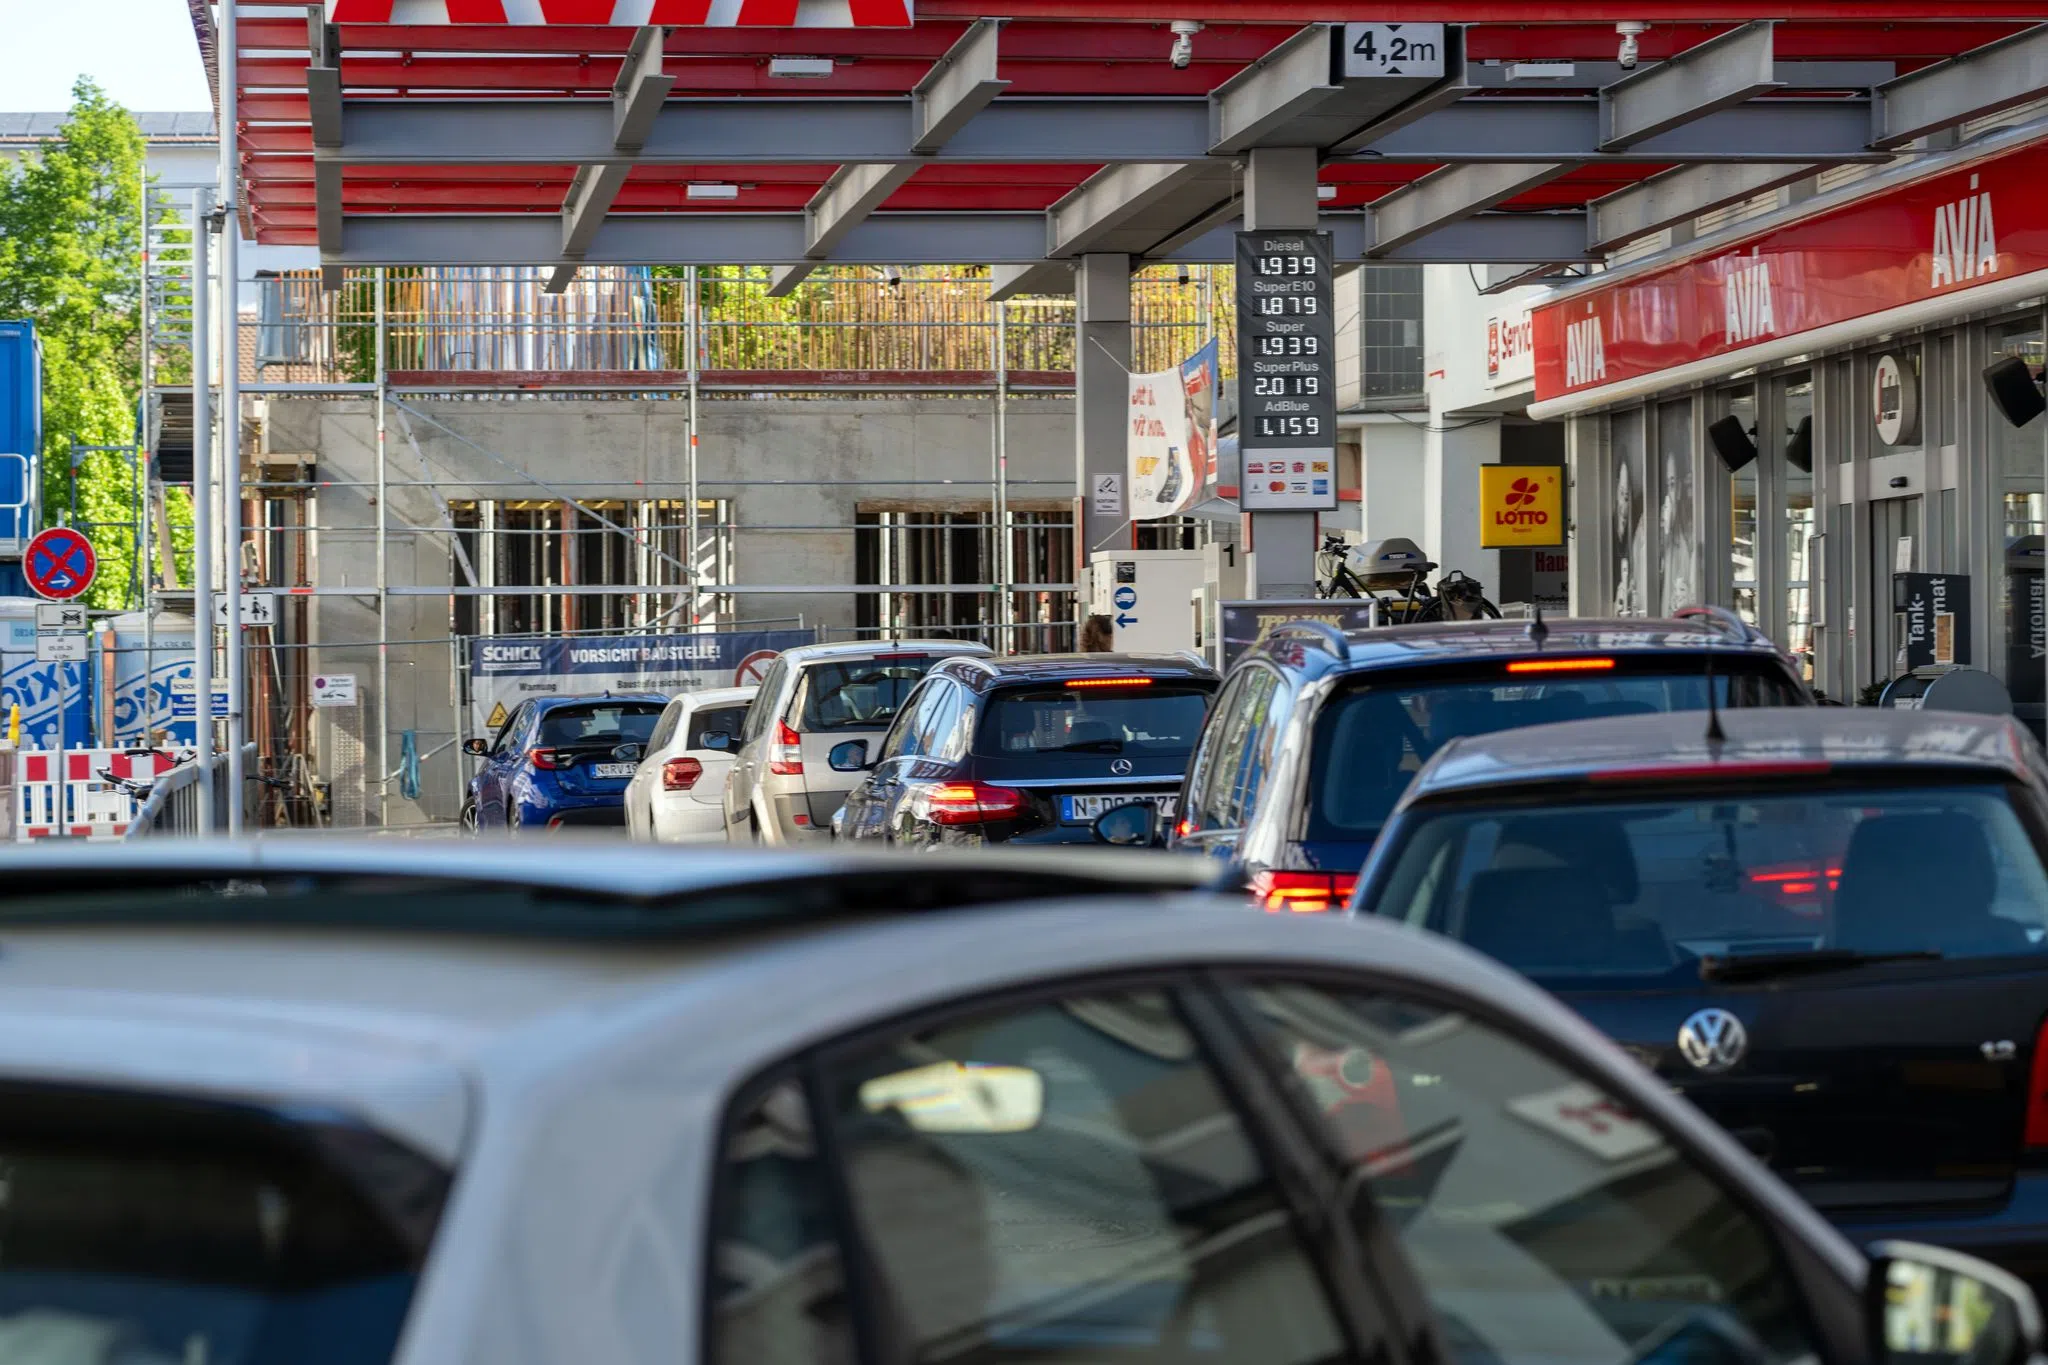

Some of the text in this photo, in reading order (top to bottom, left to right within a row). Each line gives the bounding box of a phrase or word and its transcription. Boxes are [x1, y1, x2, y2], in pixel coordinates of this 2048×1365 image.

[1353, 31, 1435, 66] 4,2m
[1264, 240, 1305, 252] Diesel
[1260, 256, 1317, 275] 1.939
[1254, 281, 1316, 293] Super E10
[1261, 297, 1318, 315] 1.879
[1266, 321, 1305, 334] Super
[1261, 337, 1318, 355] 1.939
[1253, 361, 1320, 375] Super Plus
[1254, 377, 1319, 396] 2.019
[1264, 401, 1310, 412] AdBlue
[1263, 417, 1319, 435] 1.159
[1496, 511, 1548, 525] LOTTO
[1222, 543, 1235, 568] 1
[1908, 593, 1926, 645] Tank-
[482, 645, 721, 663] SCHICK VORSICHT BAUSTELLE!
[1074, 798, 1088, 818] N
